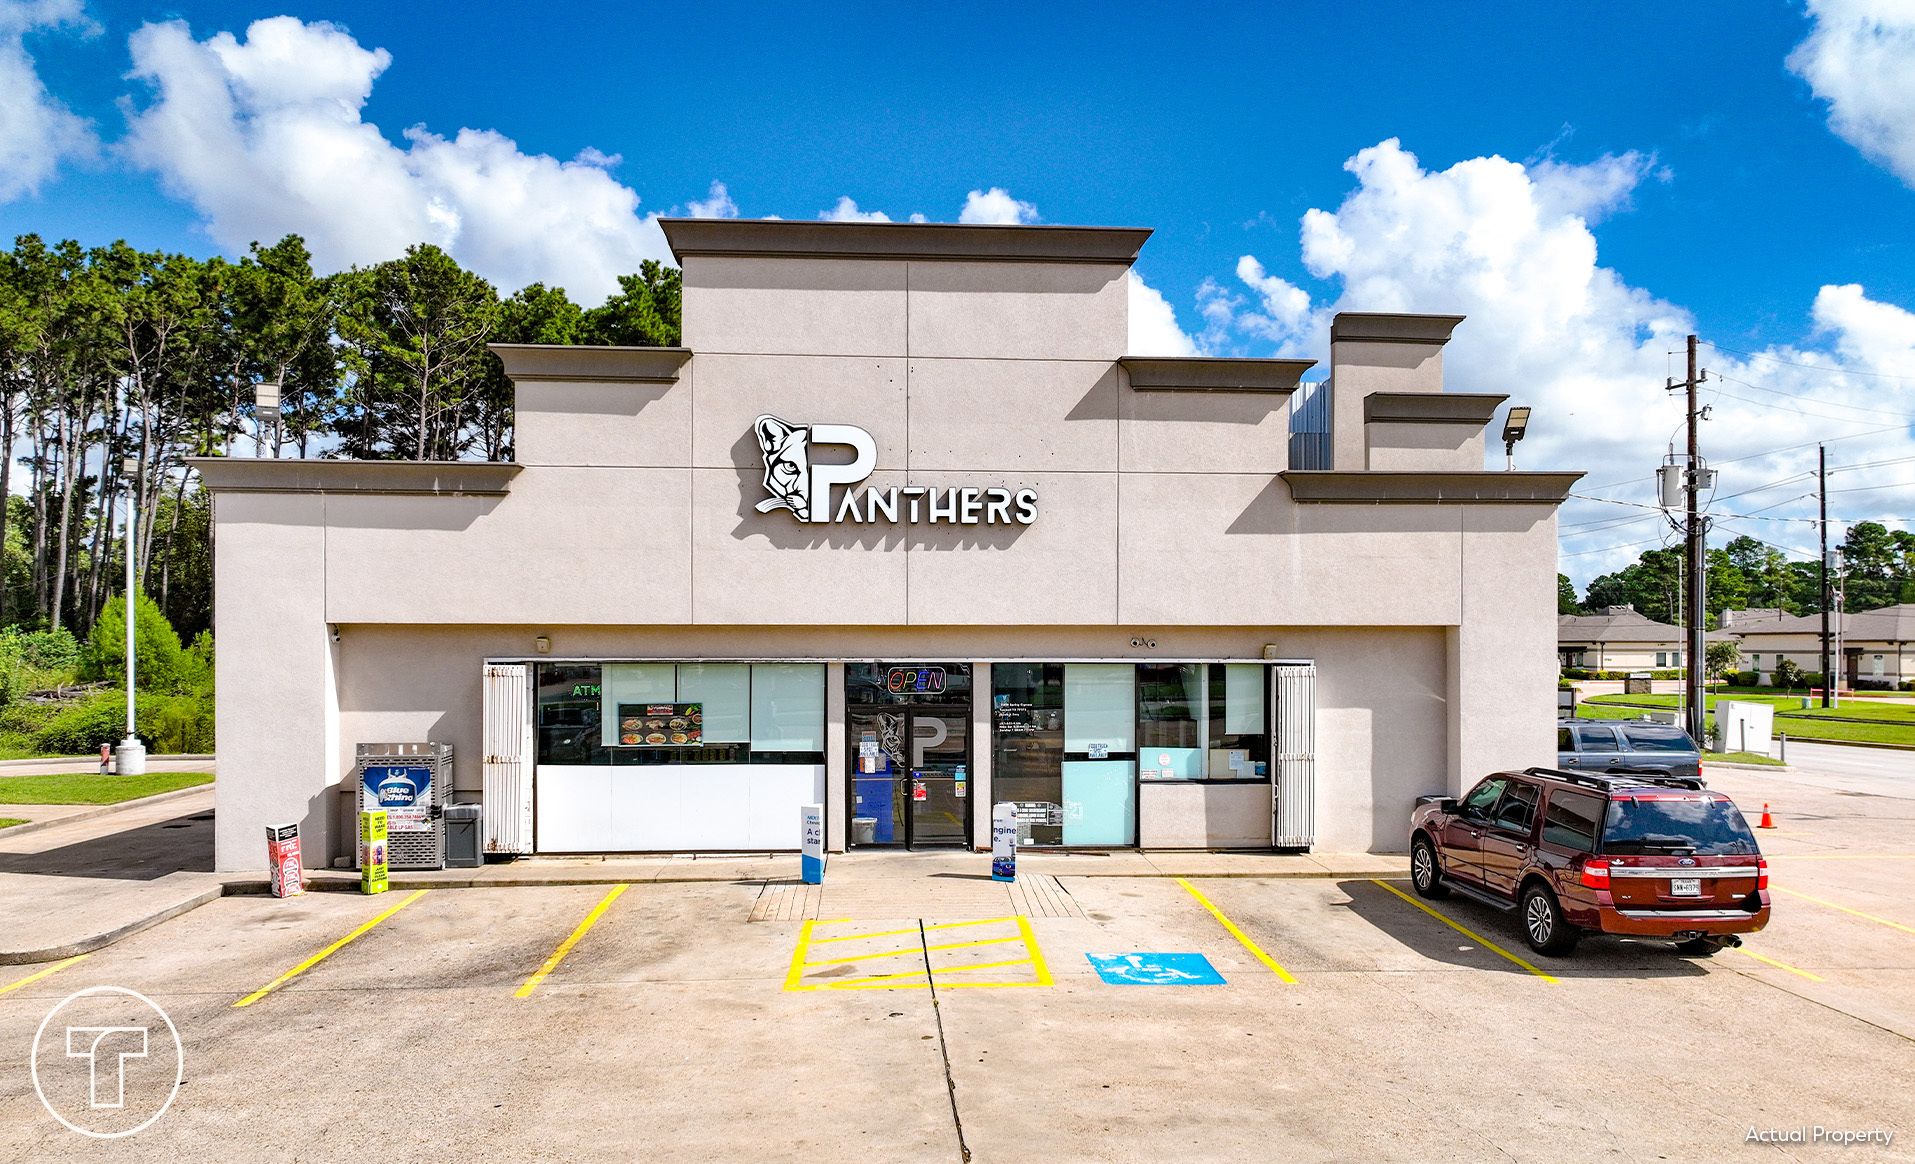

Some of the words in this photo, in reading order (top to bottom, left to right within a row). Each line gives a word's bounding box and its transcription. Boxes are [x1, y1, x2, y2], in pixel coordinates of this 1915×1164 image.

[811, 424, 1039, 524] PANTHERS
[889, 671, 943, 689] OPEN
[573, 684, 600, 697] ATM
[913, 716, 947, 767] P
[994, 826, 1016, 834] ngine
